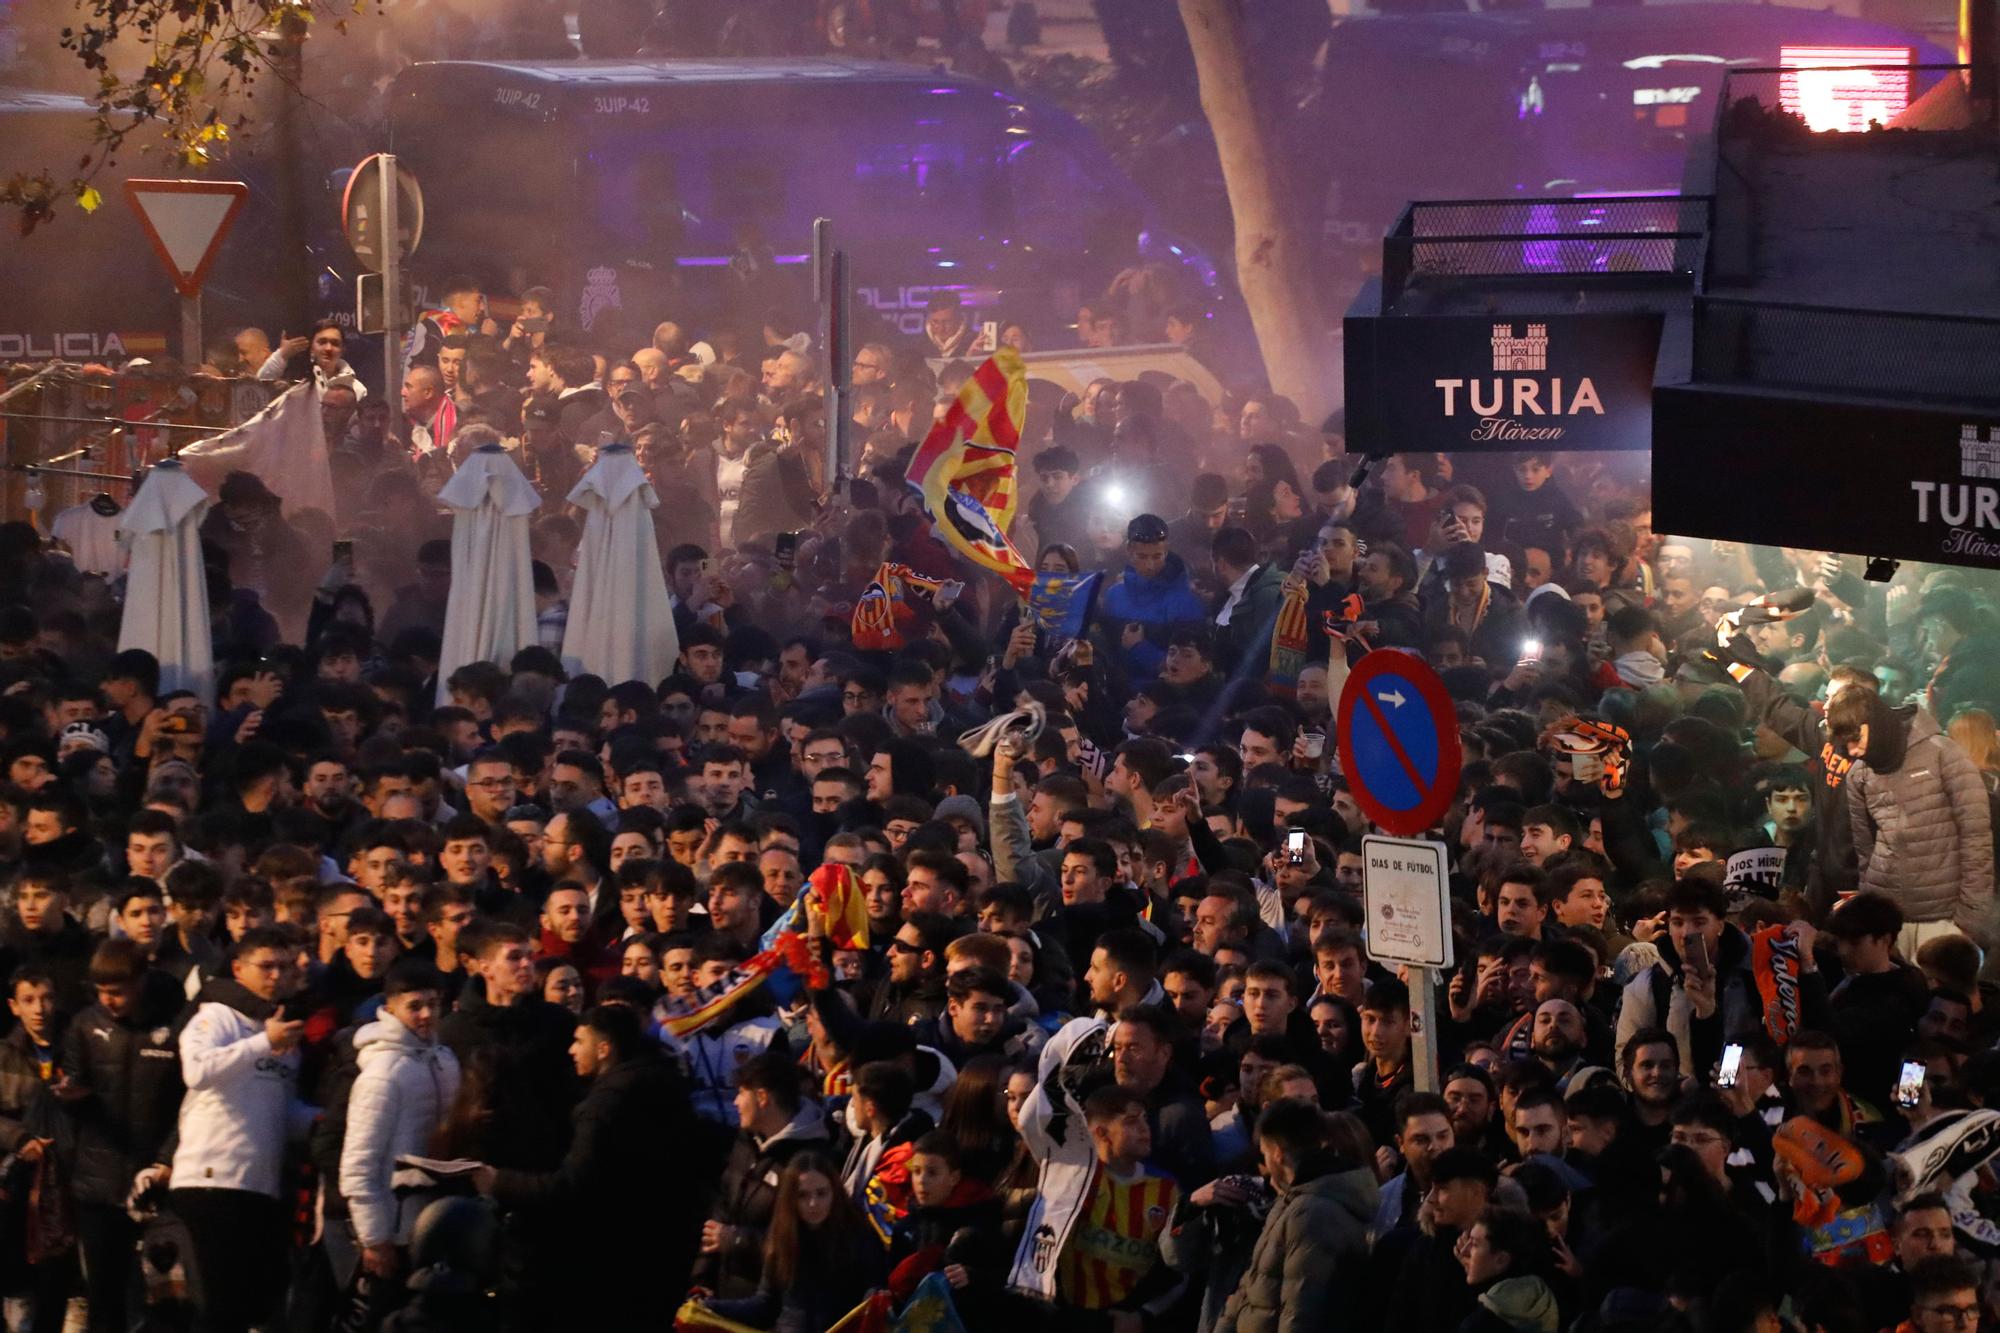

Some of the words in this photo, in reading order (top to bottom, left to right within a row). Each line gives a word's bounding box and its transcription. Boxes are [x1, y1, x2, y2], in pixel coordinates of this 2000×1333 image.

[1435, 377, 1605, 416] TURIA
[1470, 417, 1566, 441] Märzen
[1911, 481, 2000, 530] TUR
[1393, 861, 1402, 871] DE
